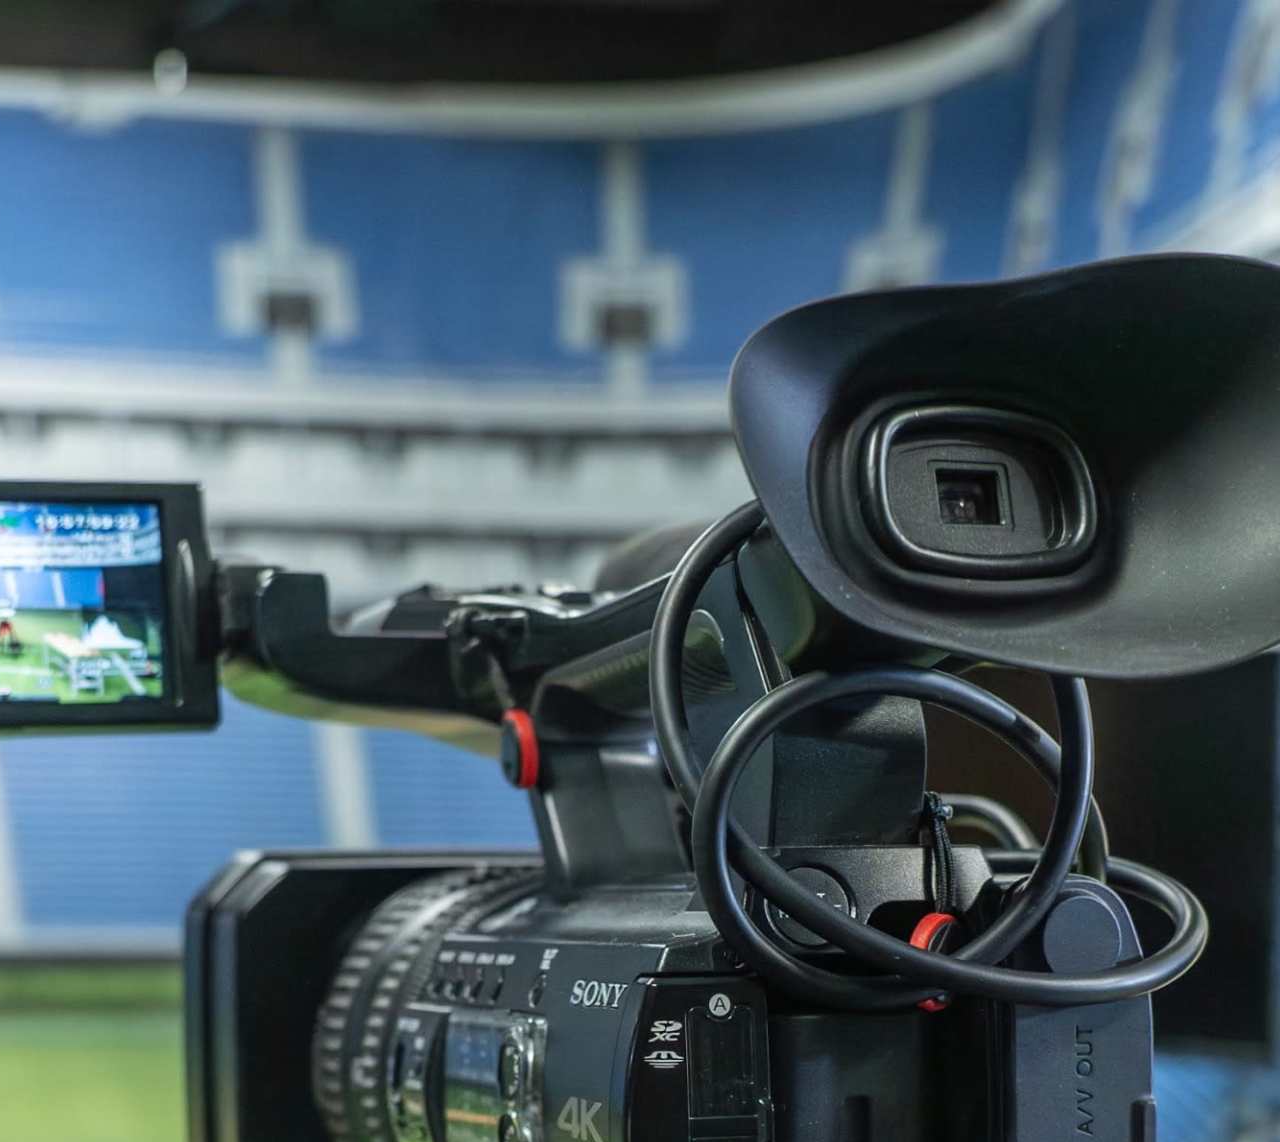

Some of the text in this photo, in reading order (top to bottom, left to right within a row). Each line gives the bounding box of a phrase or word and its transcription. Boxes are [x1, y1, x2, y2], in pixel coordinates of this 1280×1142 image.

[567, 979, 628, 1008] SONY
[712, 996, 728, 1012] A
[1072, 1023, 1095, 1137] A/V OUT
